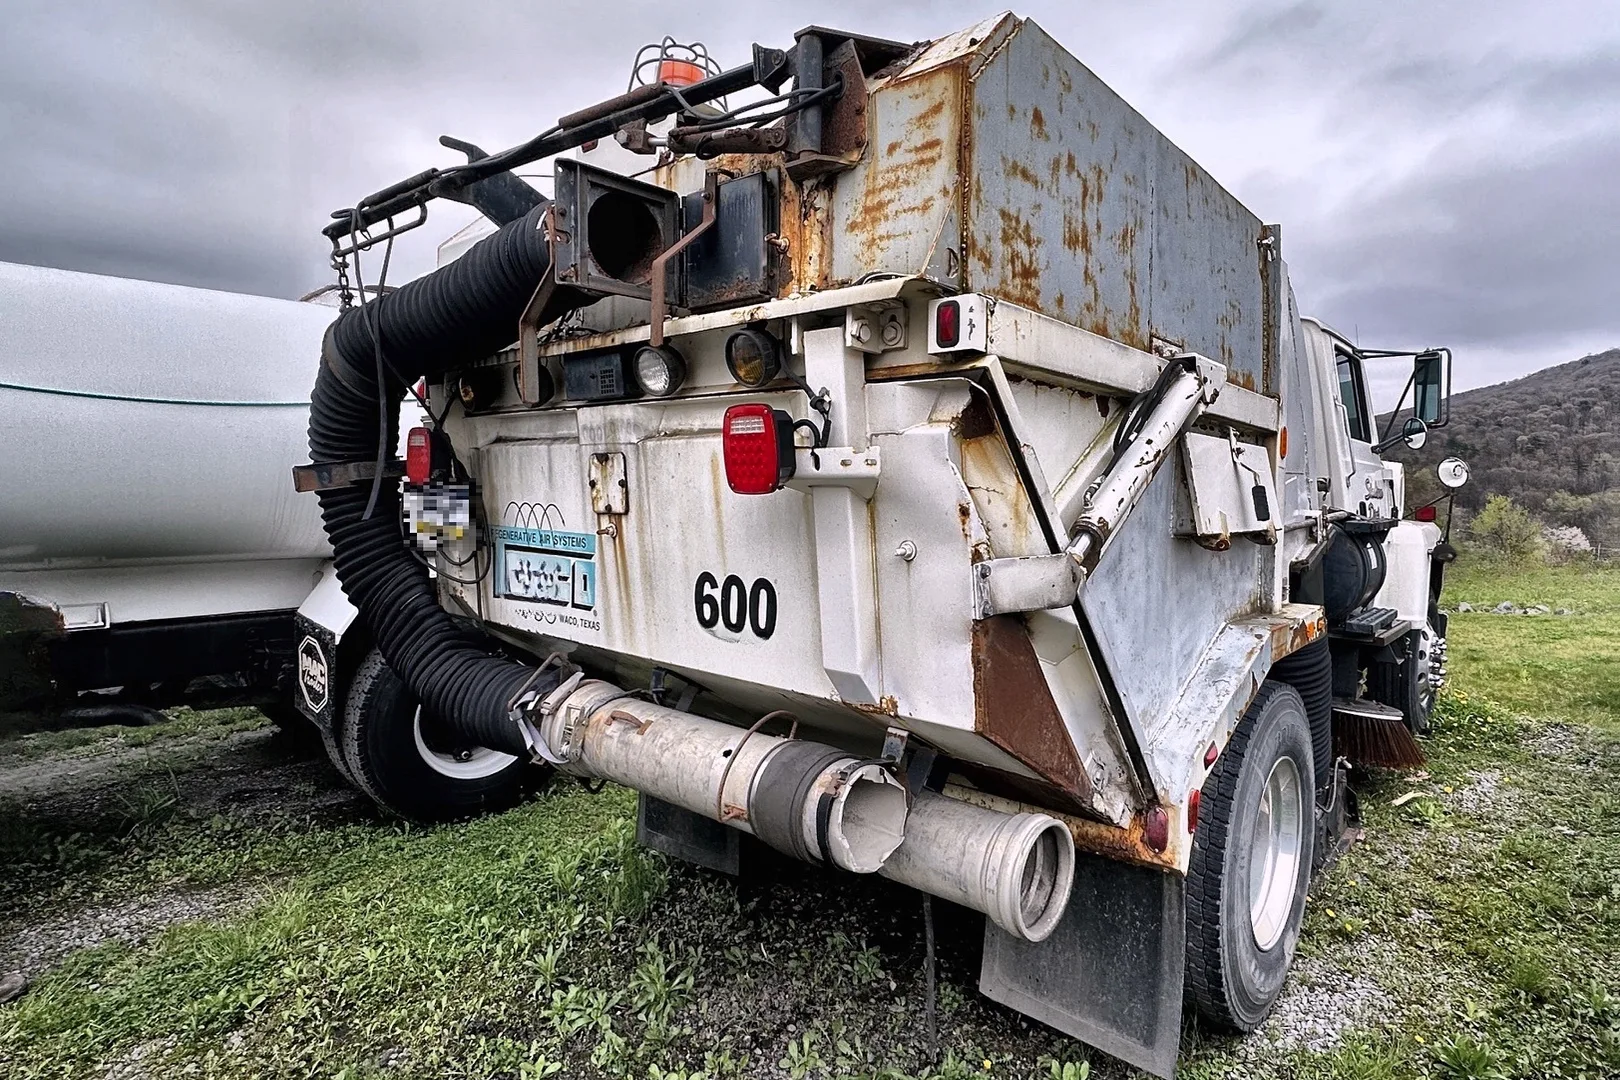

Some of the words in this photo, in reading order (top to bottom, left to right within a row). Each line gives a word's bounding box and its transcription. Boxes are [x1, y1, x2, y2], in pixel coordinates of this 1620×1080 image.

[540, 533, 551, 545] AIR
[554, 534, 587, 549] SYSTEMS
[694, 571, 777, 640] 600
[581, 618, 601, 631] TEXAS
